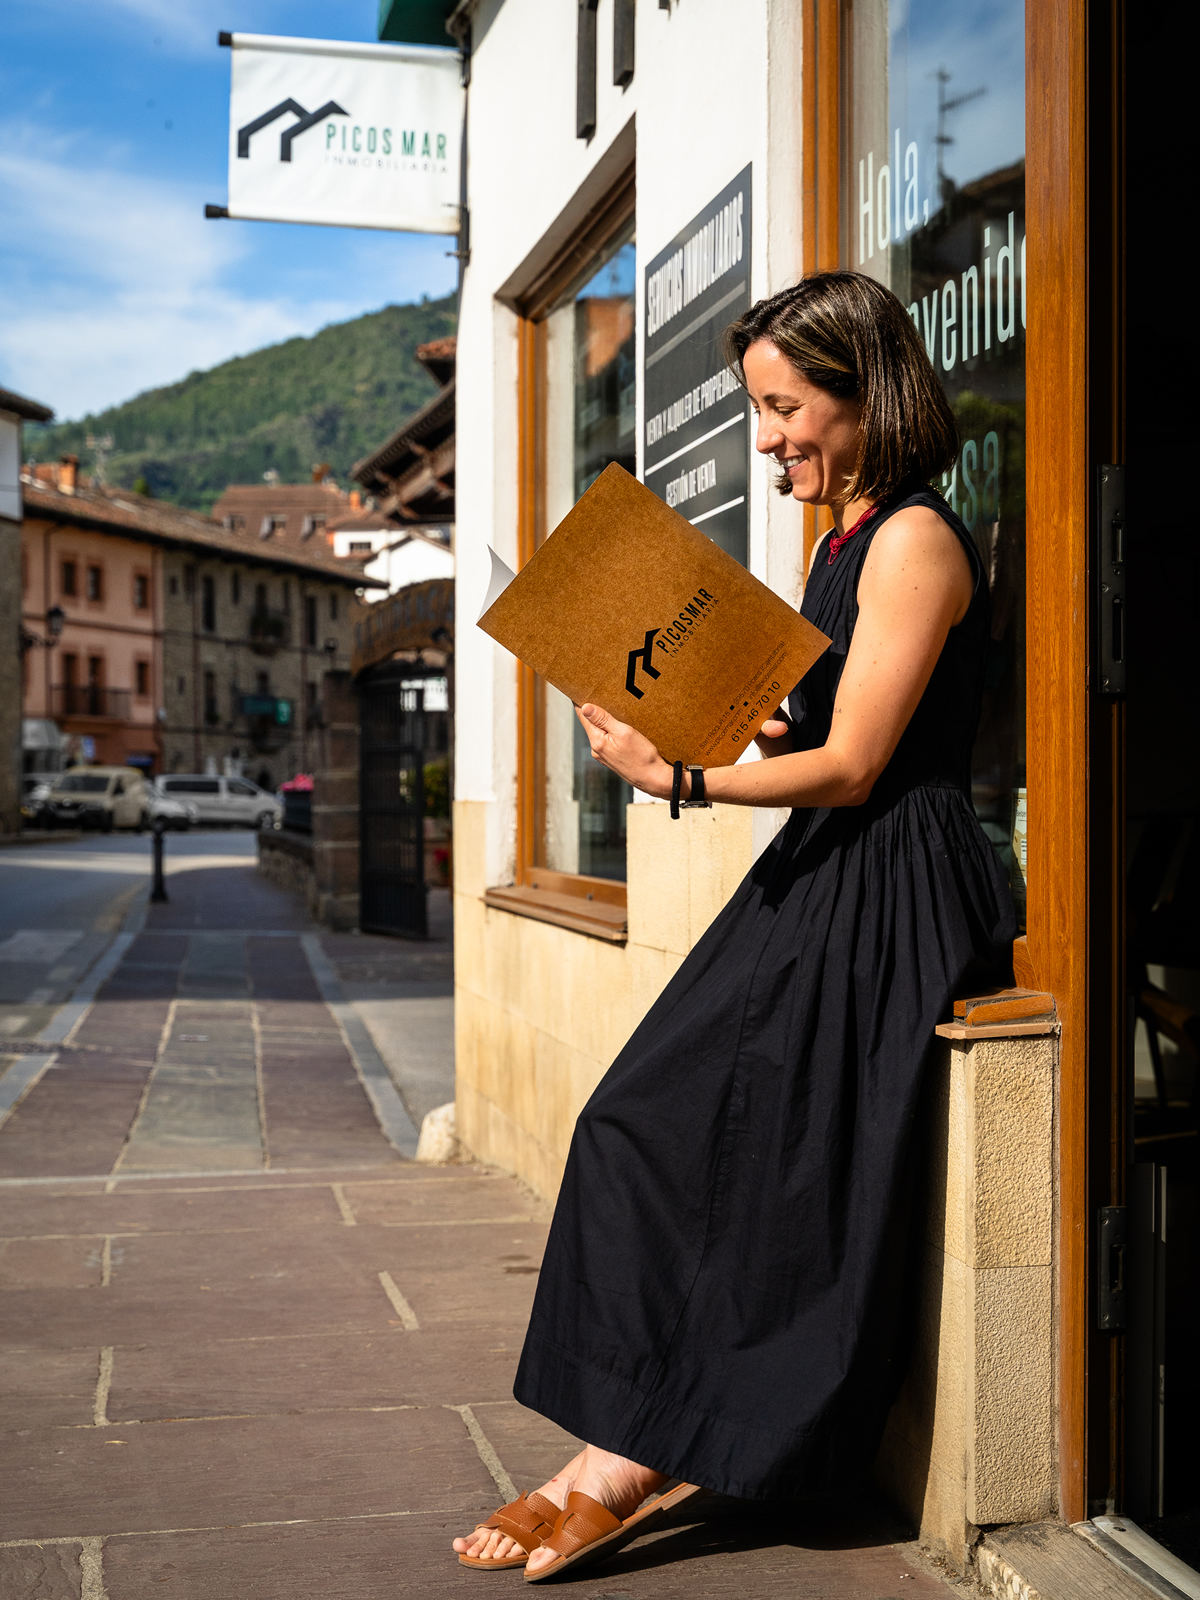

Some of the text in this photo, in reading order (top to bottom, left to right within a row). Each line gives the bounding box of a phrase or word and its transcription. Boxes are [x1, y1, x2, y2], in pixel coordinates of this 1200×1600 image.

[324, 154, 449, 174] INMOBILIARIA
[326, 123, 448, 159] PICOS MAR
[859, 127, 929, 265] Hola,
[907, 211, 1026, 371] venid
[662, 409, 668, 437] Y
[701, 360, 742, 412] PROPIEDAD
[696, 458, 716, 495] VENTA
[655, 588, 714, 654] PICOSMAR
[669, 598, 720, 658] INMOBILIARIA
[704, 708, 744, 756] www.picosmar.com
[731, 681, 781, 743] 615 46 70 10
[699, 737, 710, 749] San
